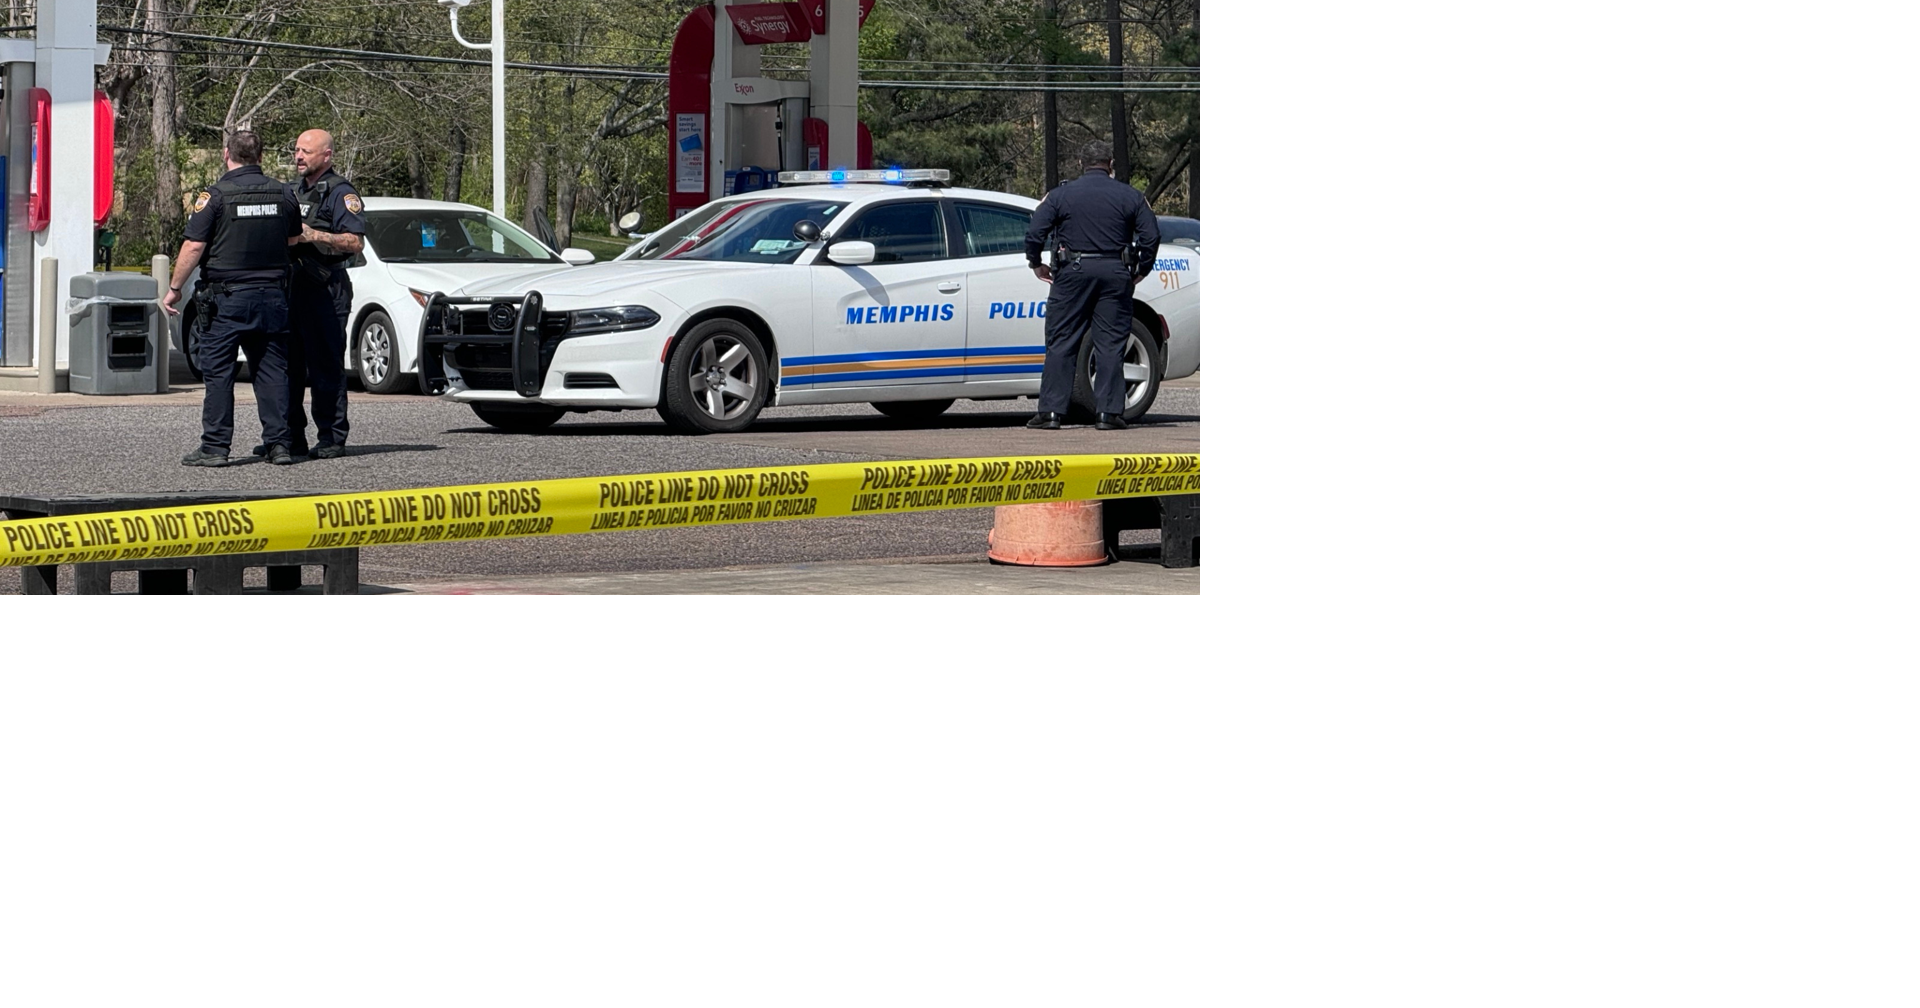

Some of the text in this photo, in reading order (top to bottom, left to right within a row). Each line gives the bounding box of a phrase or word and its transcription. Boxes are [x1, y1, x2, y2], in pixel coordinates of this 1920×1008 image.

[815, 4, 823, 17] 6
[750, 20, 790, 34] Synergy
[734, 83, 754, 96] Exxon
[237, 204, 278, 217] MEMPHIS POLICE
[1152, 258, 1190, 271] ERGENCY
[1159, 271, 1180, 290] 911
[846, 301, 1047, 325] MEMPHIS POLIC
[860, 459, 1063, 491] POLICE LINE DO NOT CROSS
[1107, 456, 1198, 476] POLICE LINE
[599, 471, 809, 508] POLICE LINE DO NOT CROSS
[851, 481, 1065, 512] LINEA DE POLICIA POR FAVOR NO CRUZAR
[1096, 475, 1200, 495] LINEA DE POLICIA PO
[314, 487, 541, 529] POLICE LINE DO NOT CROSS
[590, 497, 817, 530] LINEA DE POLICIA POR FAVOR NO CRUZAR
[3, 508, 254, 552] POLICE LINE DO NOT CROSS
[305, 517, 554, 548] LINEA DE POLICIA POR FAVOR NO CRUZAR
[42, 553, 64, 564] DE
[65, 549, 117, 563] POLICIA
[119, 547, 149, 560] POR
[148, 544, 192, 558] FAVOR
[192, 542, 214, 555] NO
[213, 538, 269, 554] CRUZAR
